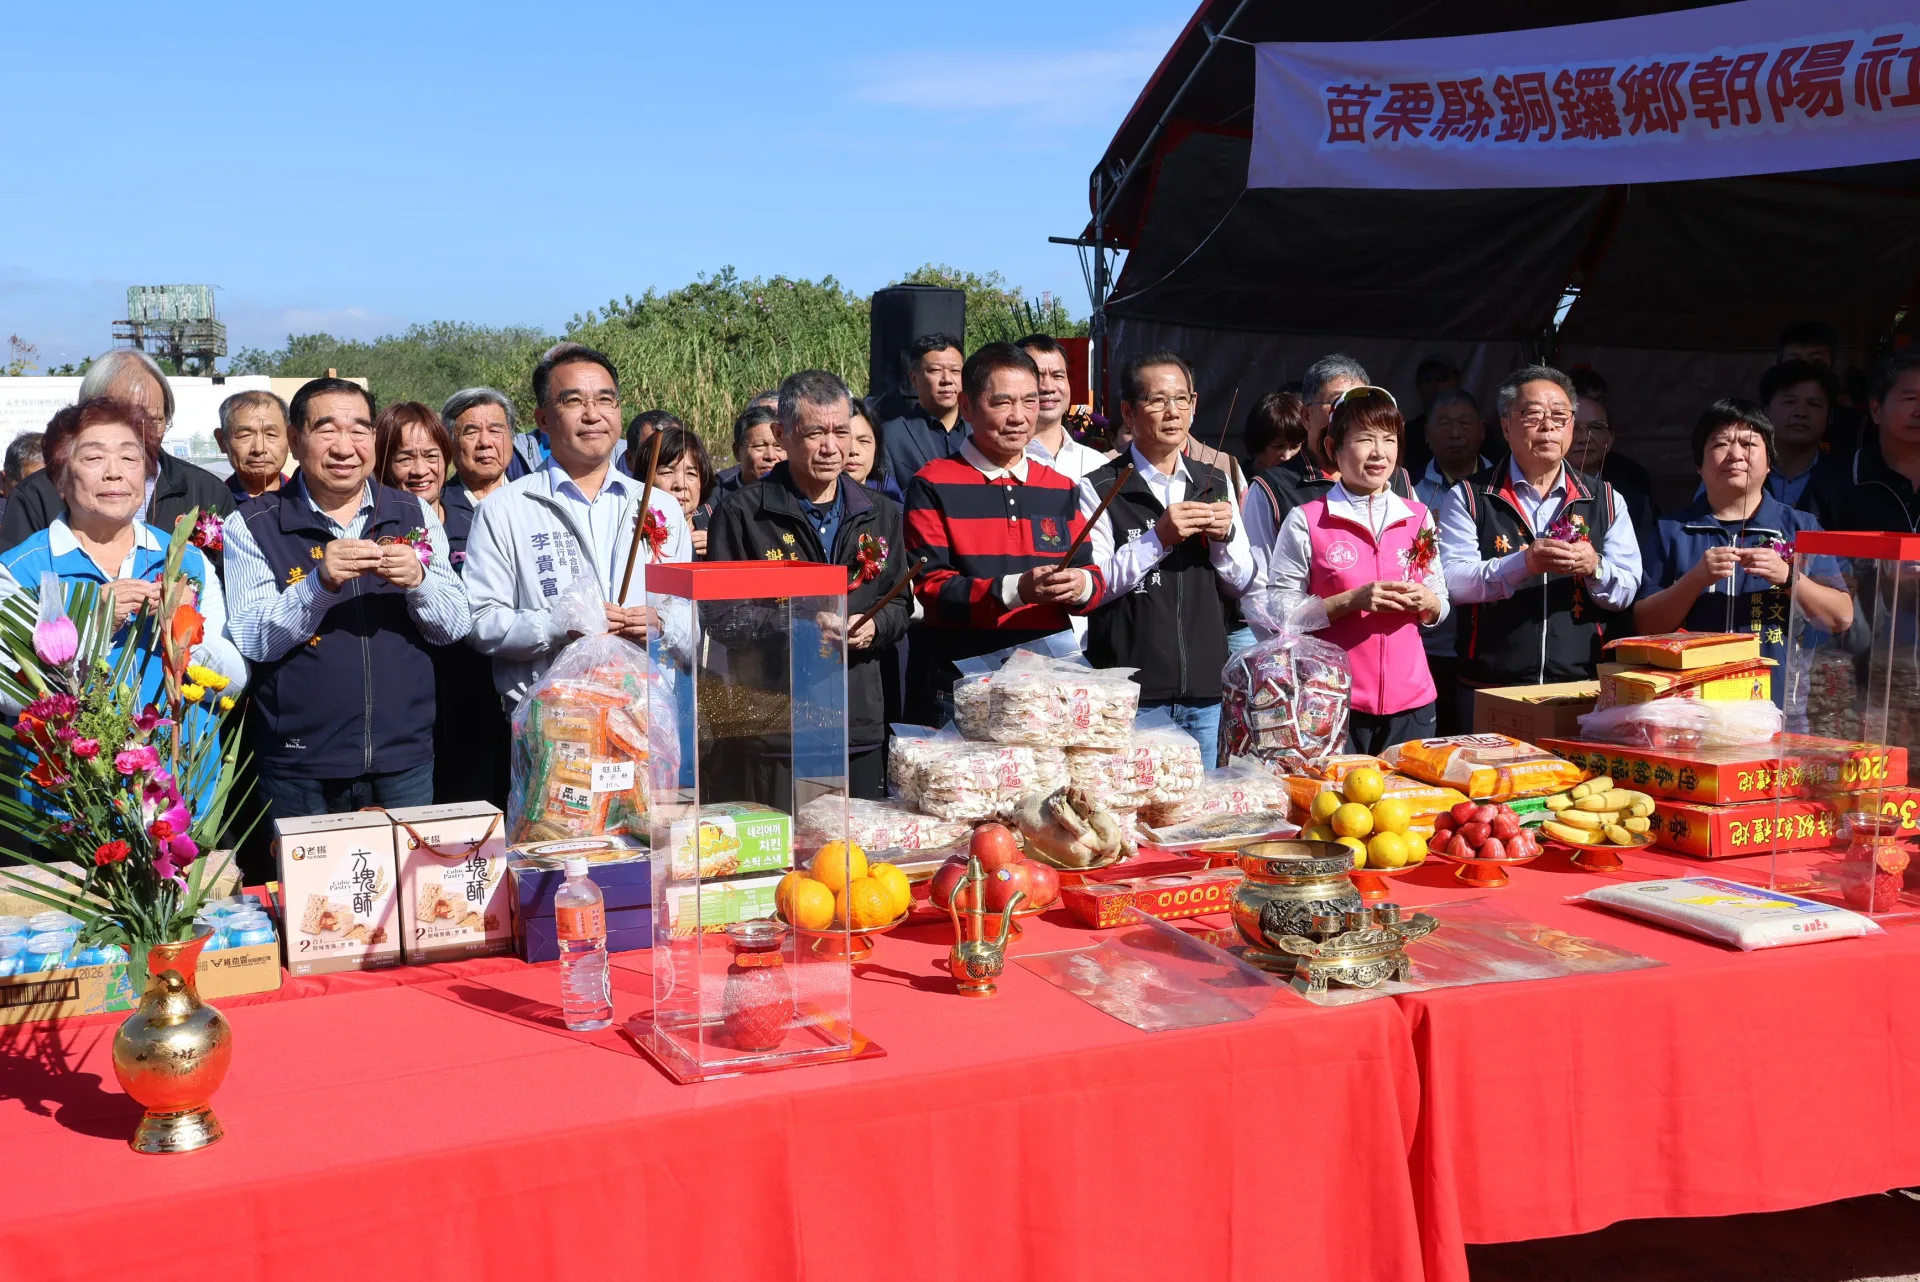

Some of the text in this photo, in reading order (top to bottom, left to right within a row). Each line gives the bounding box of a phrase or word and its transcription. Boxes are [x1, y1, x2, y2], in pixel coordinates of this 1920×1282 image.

[1326, 33, 1920, 144] 苗栗縣銅鑼鄉朝陽社
[551, 531, 567, 566] 副執行長
[530, 532, 559, 598] 李貴富
[747, 824, 781, 837] 데리야끼
[759, 838, 781, 851] 치킨
[742, 854, 782, 868] 스틱 스낵
[351, 849, 379, 918] 方塊酥
[79, 966, 103, 980] 2026
